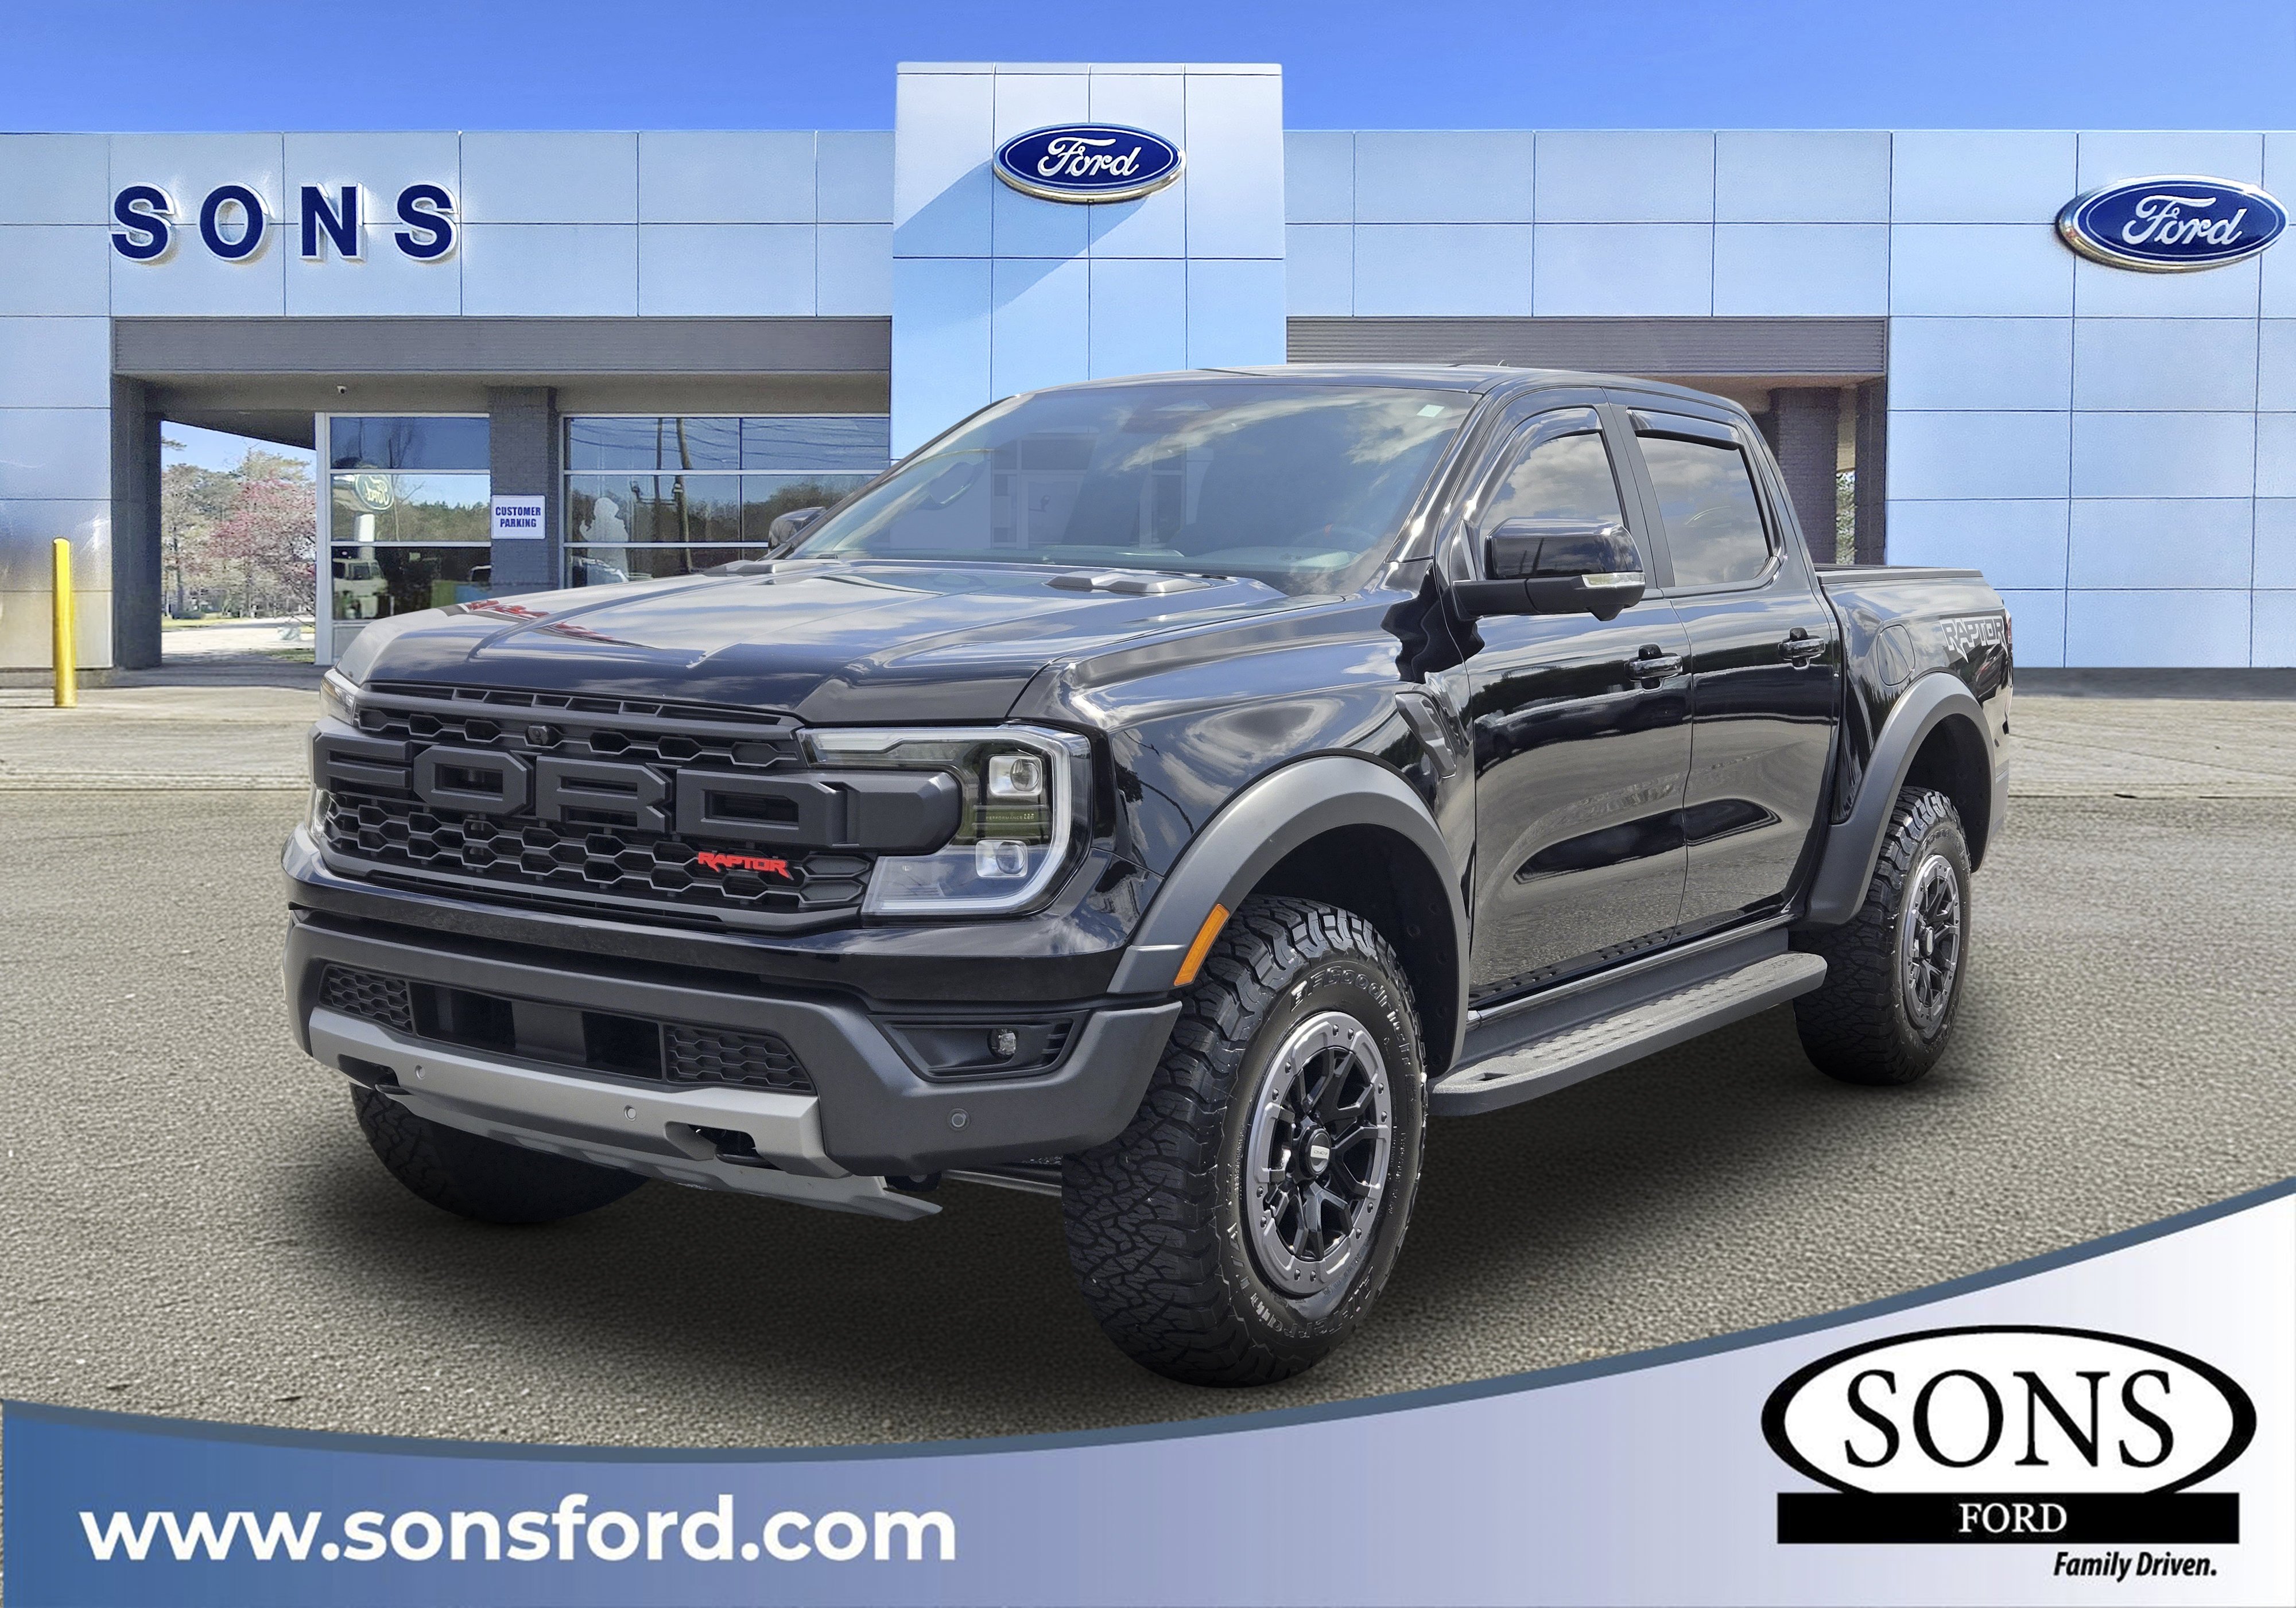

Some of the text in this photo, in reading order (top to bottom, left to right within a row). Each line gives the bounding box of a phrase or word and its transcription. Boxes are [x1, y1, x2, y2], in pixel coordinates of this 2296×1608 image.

[1038, 137, 1142, 177] Ford
[111, 184, 457, 261] SONS
[2122, 195, 2247, 245] Ford
[495, 506, 541, 516] CUSTOMER
[500, 518, 537, 527] PARKING
[1940, 615, 2008, 663] RAPTOR
[312, 723, 861, 846] FORD
[697, 851, 794, 880] RAPTOR
